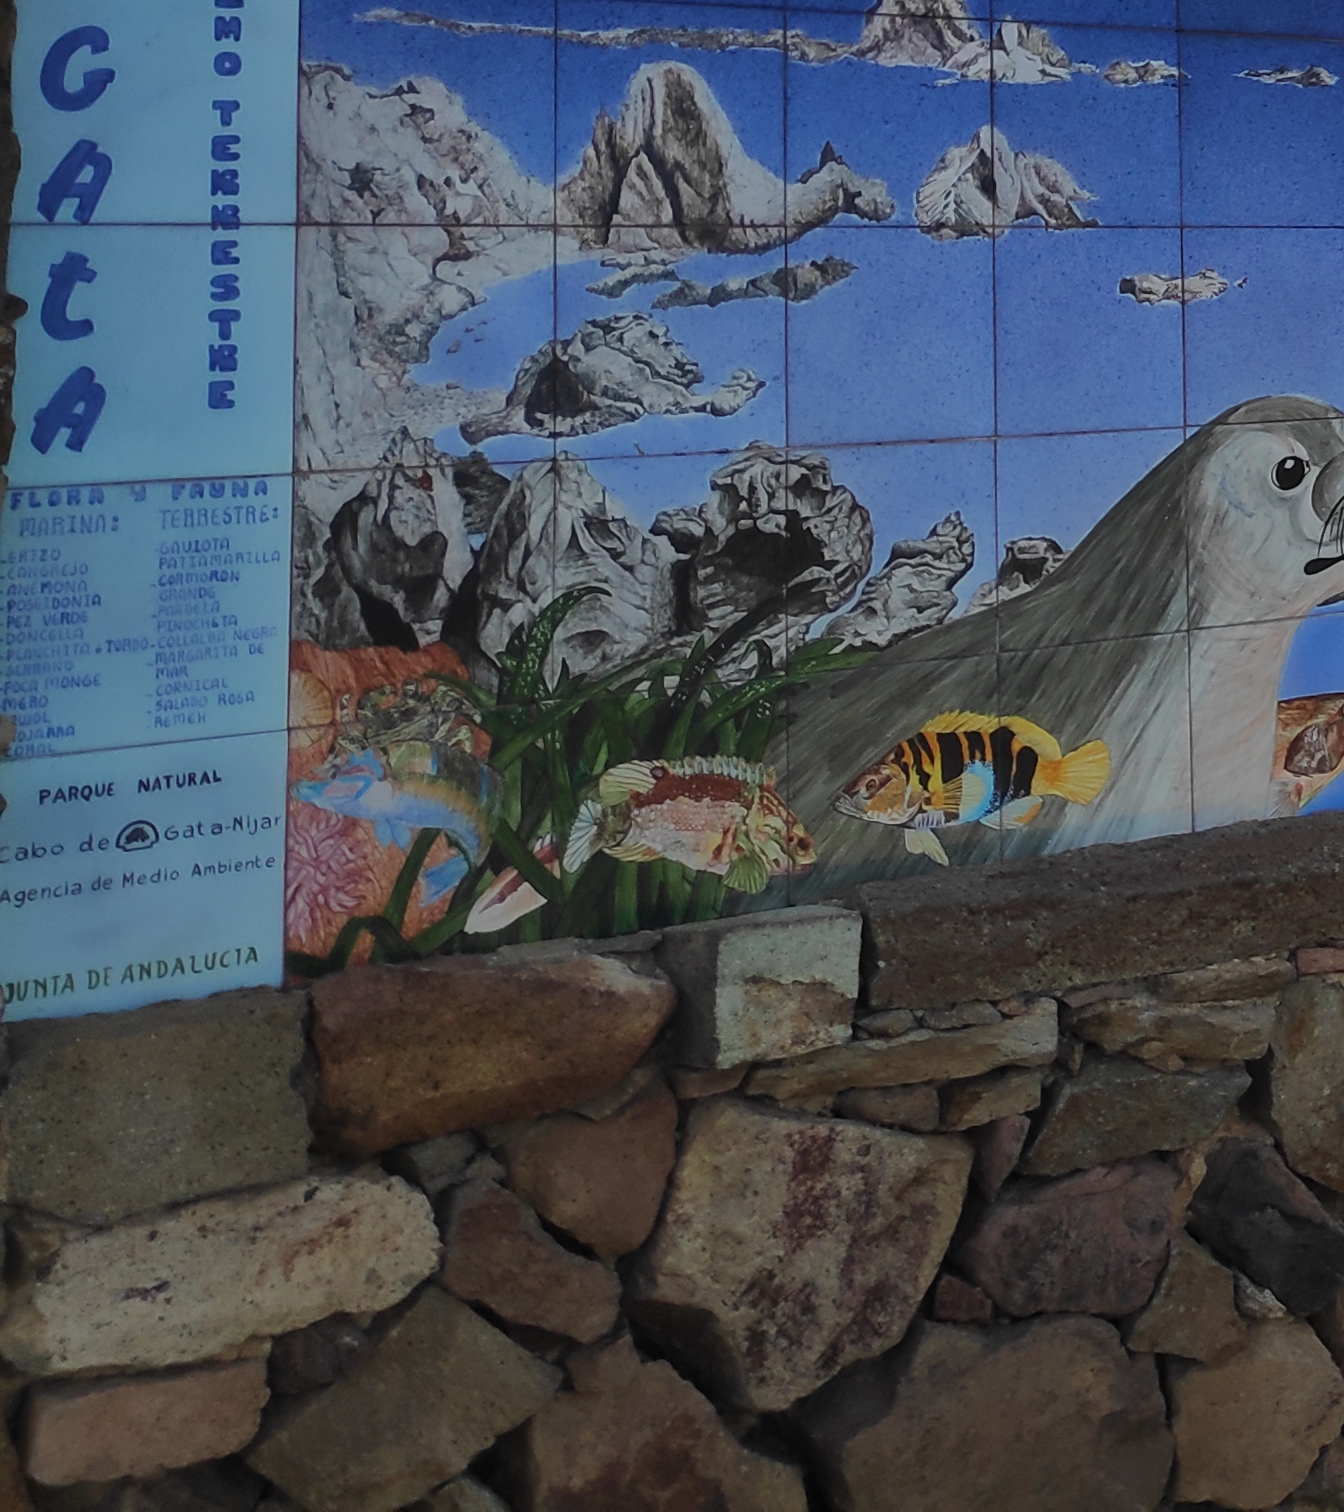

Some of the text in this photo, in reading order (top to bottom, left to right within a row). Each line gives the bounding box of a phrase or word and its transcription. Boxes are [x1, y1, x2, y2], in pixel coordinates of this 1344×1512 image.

[207, 99, 241, 410] TERRESTRE
[10, 487, 105, 510] FLORA
[172, 480, 268, 500] FAUNA
[19, 513, 119, 537] MARINA:
[159, 505, 279, 529] TERRESTRE:
[158, 550, 281, 570] PATIAMARILLA
[217, 690, 255, 706] ROSA
[39, 769, 222, 805] PARQUE NATURAL
[79, 833, 109, 852] de
[0, 854, 275, 908] Agencia de Medio Ambiente
[3, 946, 258, 1004] JUNTA DE ANDALUCIA
